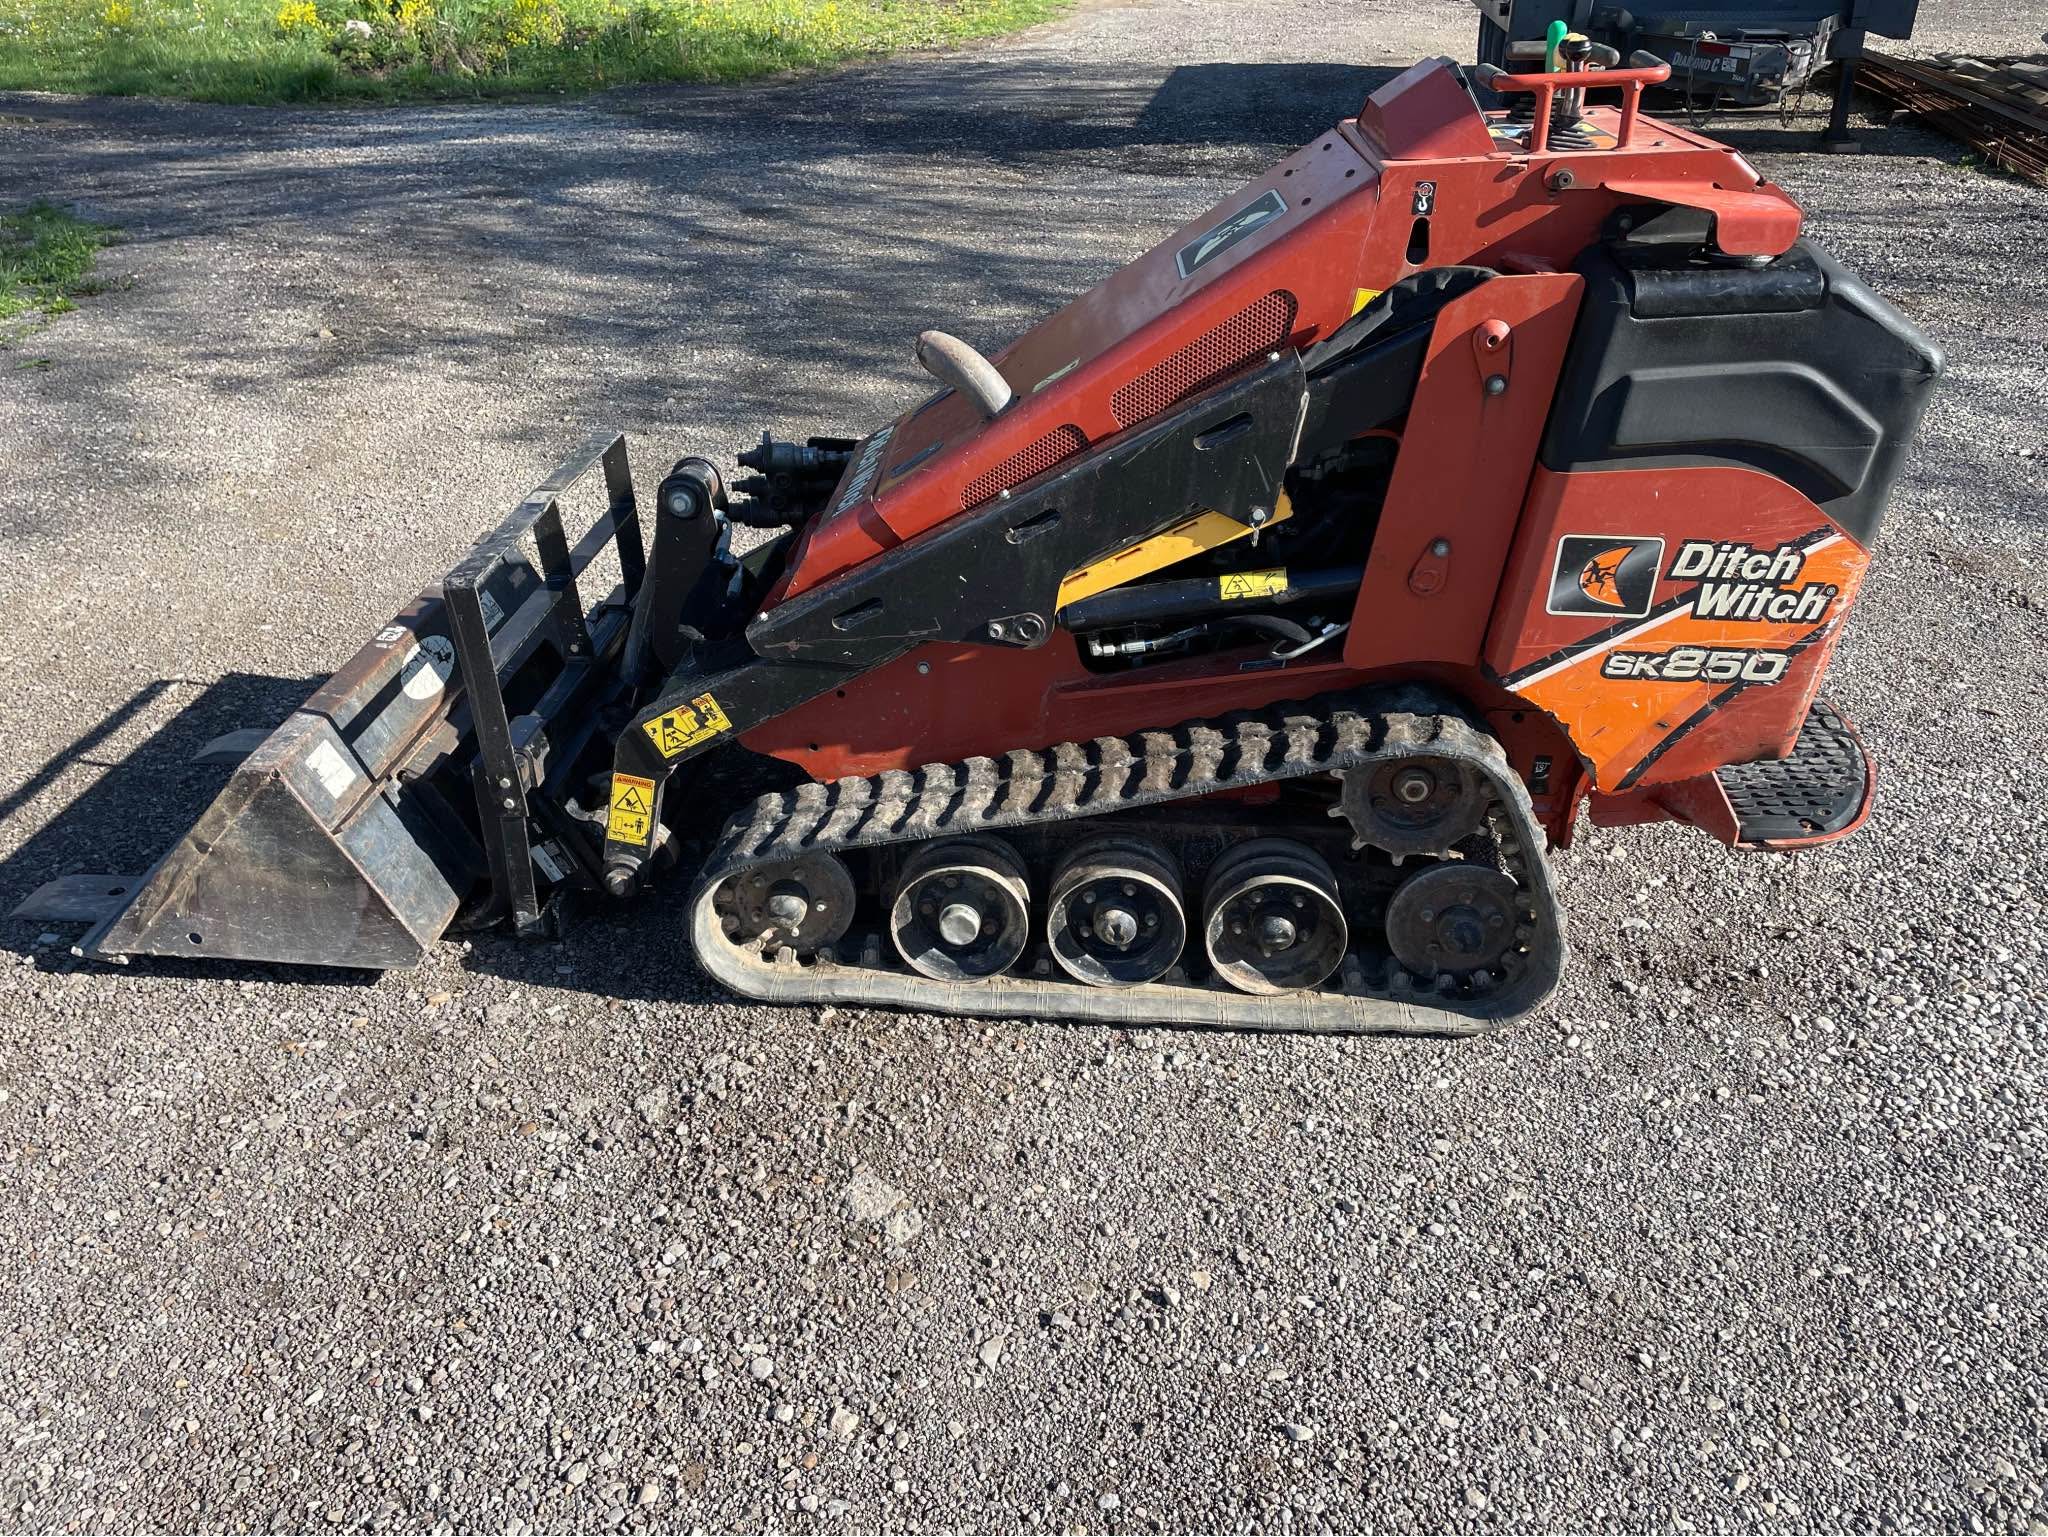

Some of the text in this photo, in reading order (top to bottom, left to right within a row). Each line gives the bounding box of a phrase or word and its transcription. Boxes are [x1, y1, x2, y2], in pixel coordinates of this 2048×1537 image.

[1711, 57, 1720, 73] C
[1671, 543, 1801, 580] Ditch
[1605, 650, 1788, 682] SK850
[622, 778, 652, 788] WARNING
